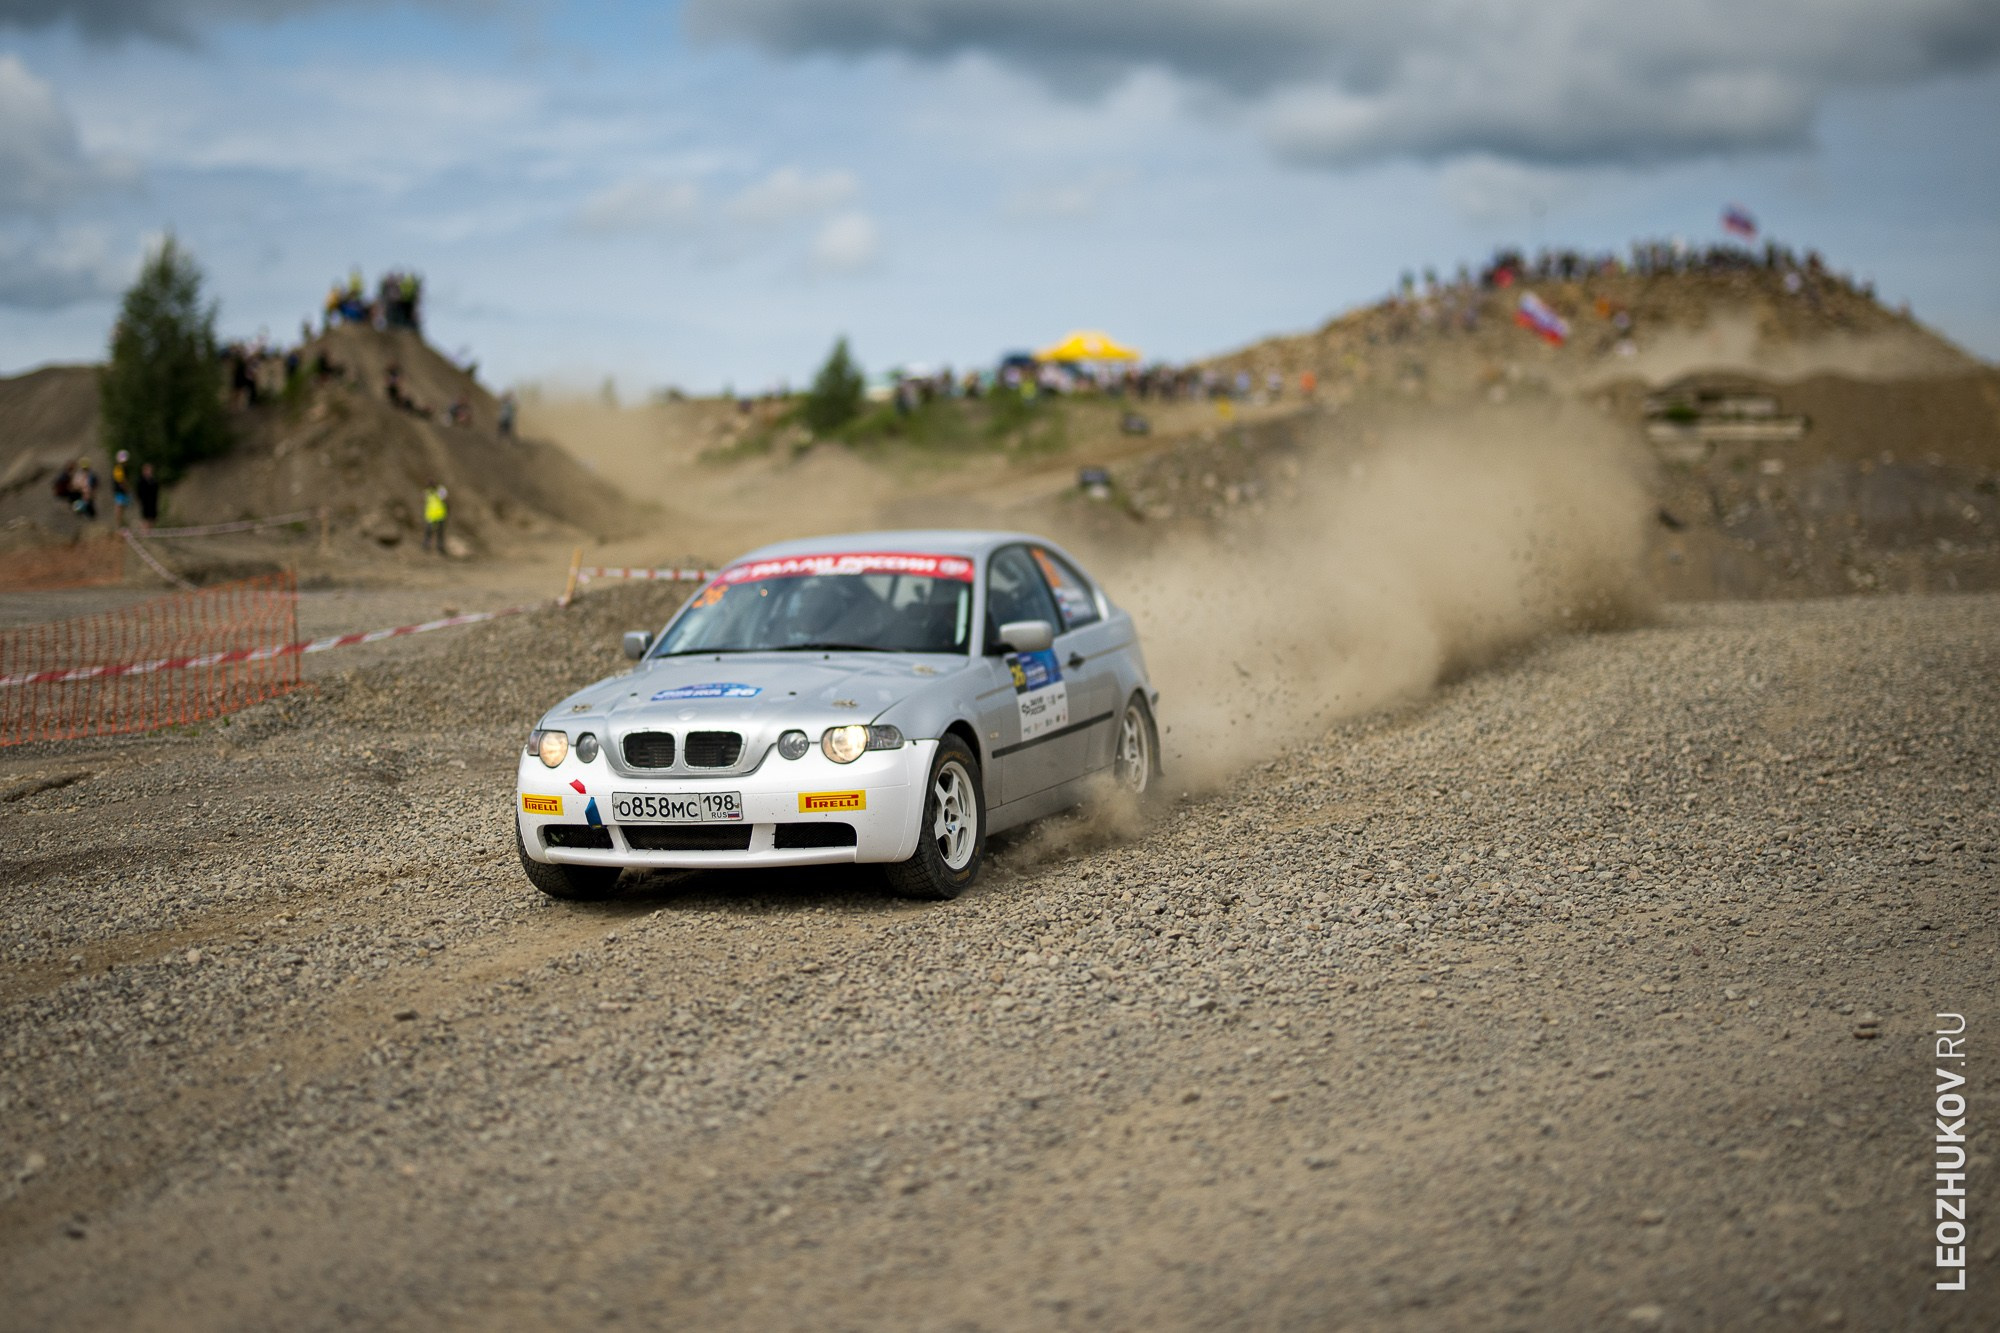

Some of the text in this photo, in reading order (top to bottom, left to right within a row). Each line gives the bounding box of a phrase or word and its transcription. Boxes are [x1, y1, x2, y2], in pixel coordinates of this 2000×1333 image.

[524, 797, 558, 811] PIRELLI
[703, 794, 735, 812] 198
[805, 794, 859, 809] PIRELLI
[711, 811, 728, 819] RUS
